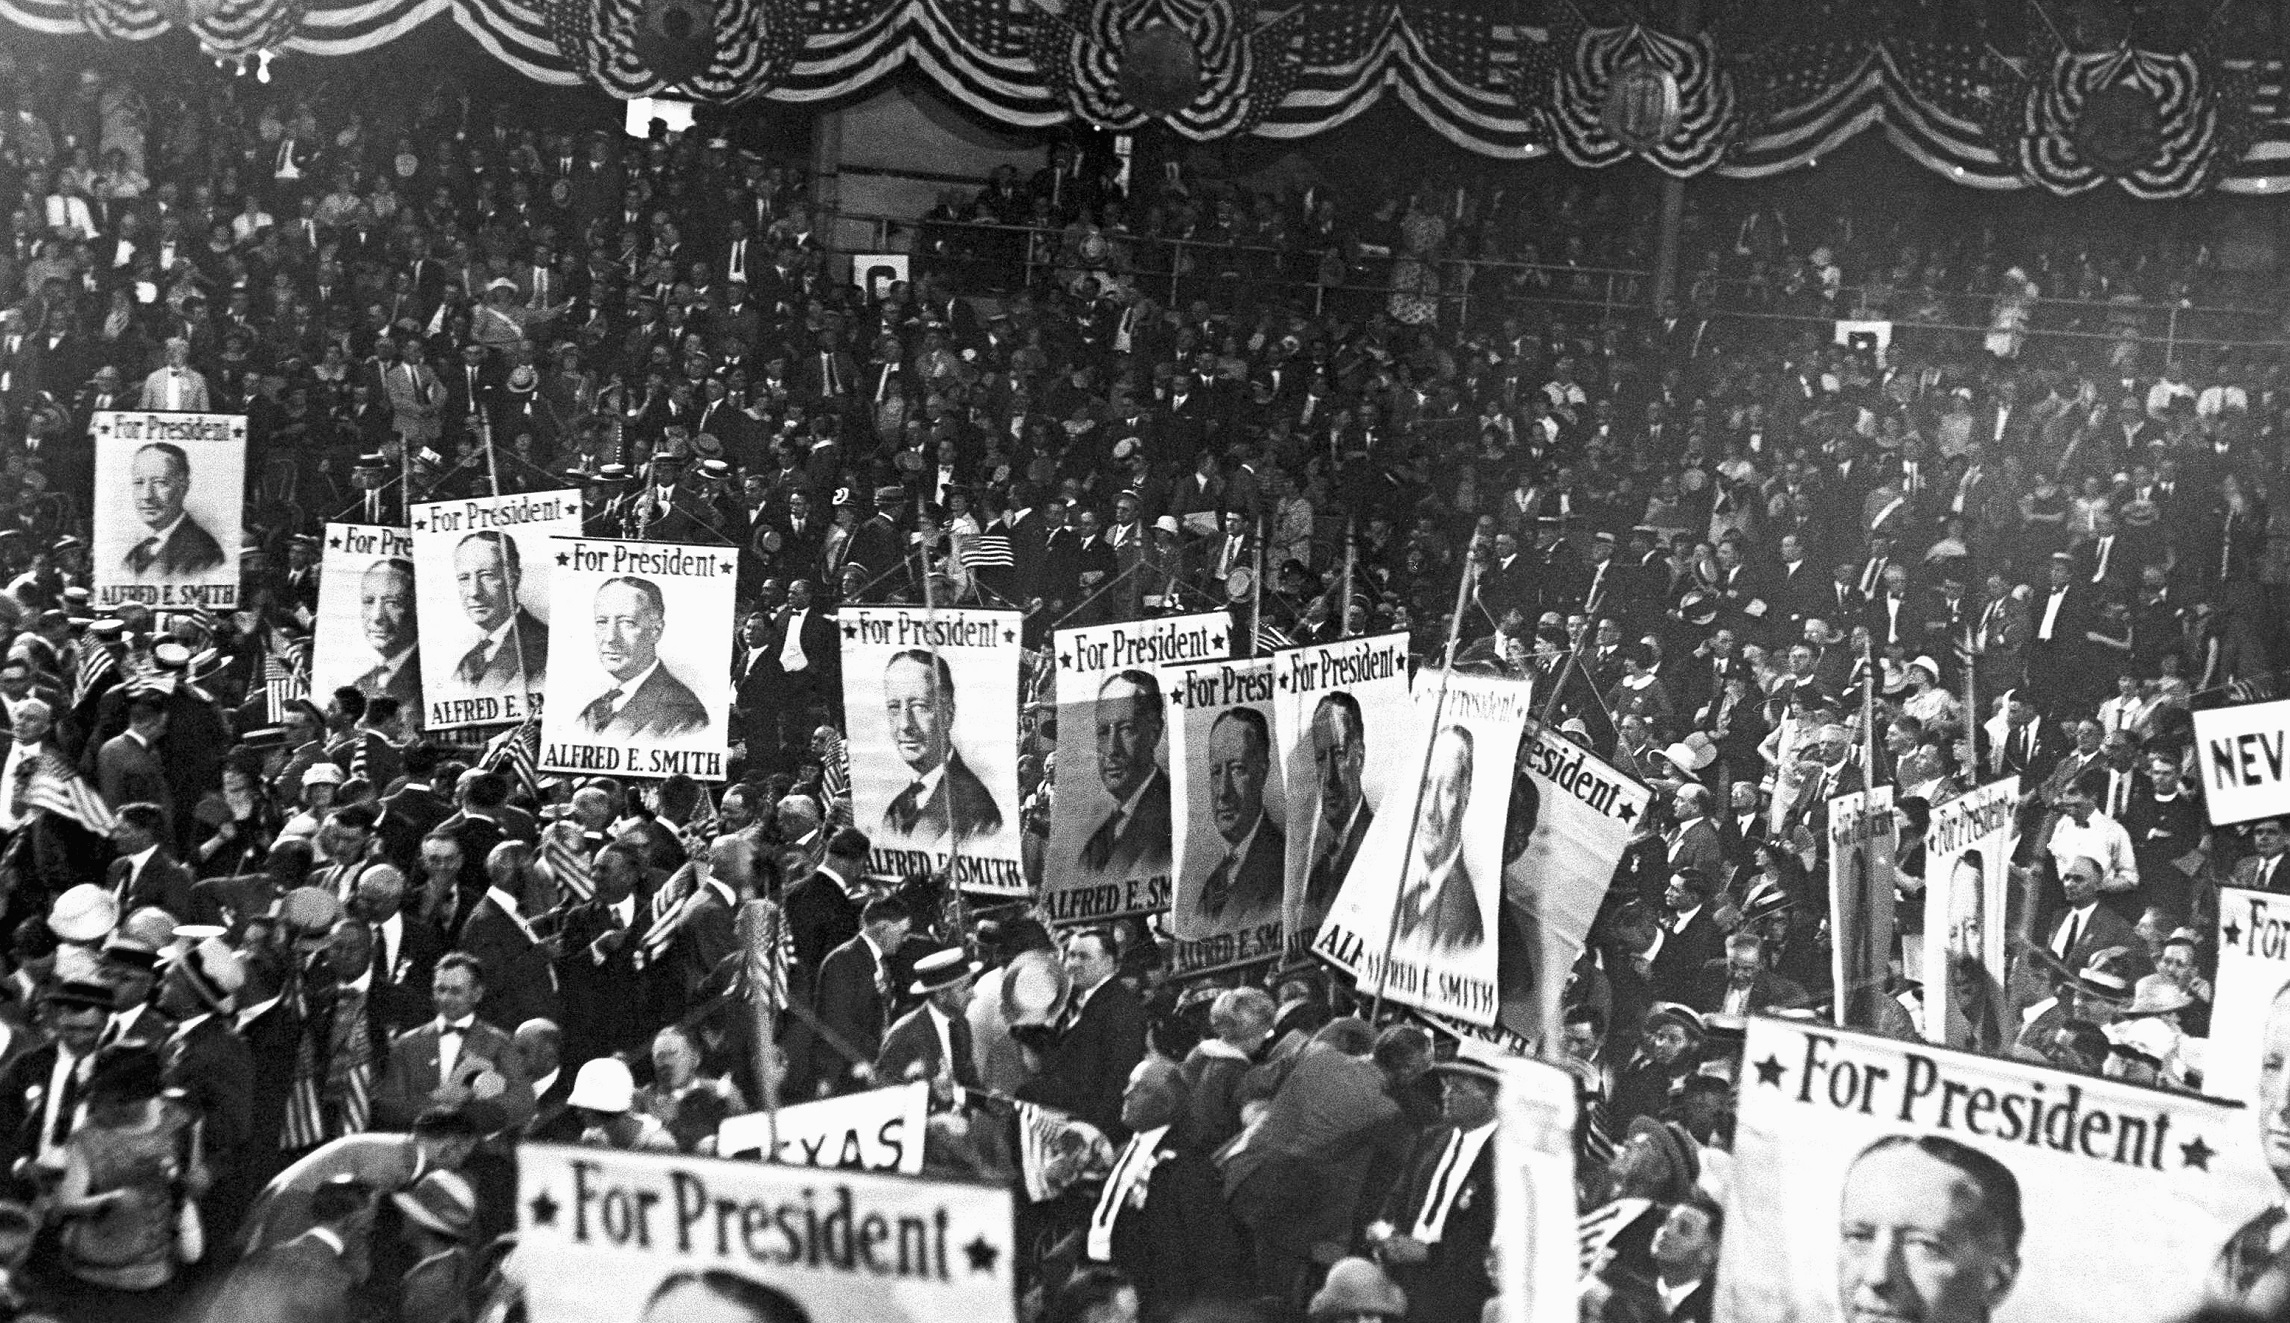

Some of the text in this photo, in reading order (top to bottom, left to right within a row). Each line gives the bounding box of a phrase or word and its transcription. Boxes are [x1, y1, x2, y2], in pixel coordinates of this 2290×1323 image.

[114, 414, 230, 442] For President
[429, 496, 563, 533] For President
[344, 526, 378, 555] For
[573, 543, 717, 578] For President
[98, 584, 159, 606] ALFRED
[178, 583, 235, 606] SMITH
[858, 610, 999, 648] For President
[1074, 622, 1210, 673] For President
[1185, 664, 1274, 709] For Presi
[1290, 642, 1394, 695] For President
[431, 697, 500, 726] ALFRED
[504, 694, 522, 719] E.
[545, 744, 722, 776] ALFRED E. SMITH
[957, 855, 1023, 888] SMITH
[1046, 883, 1121, 920] ALFRED
[1438, 971, 1494, 1014] SMITH
[1796, 1032, 2172, 1172] For President
[570, 1160, 952, 1283] For President
